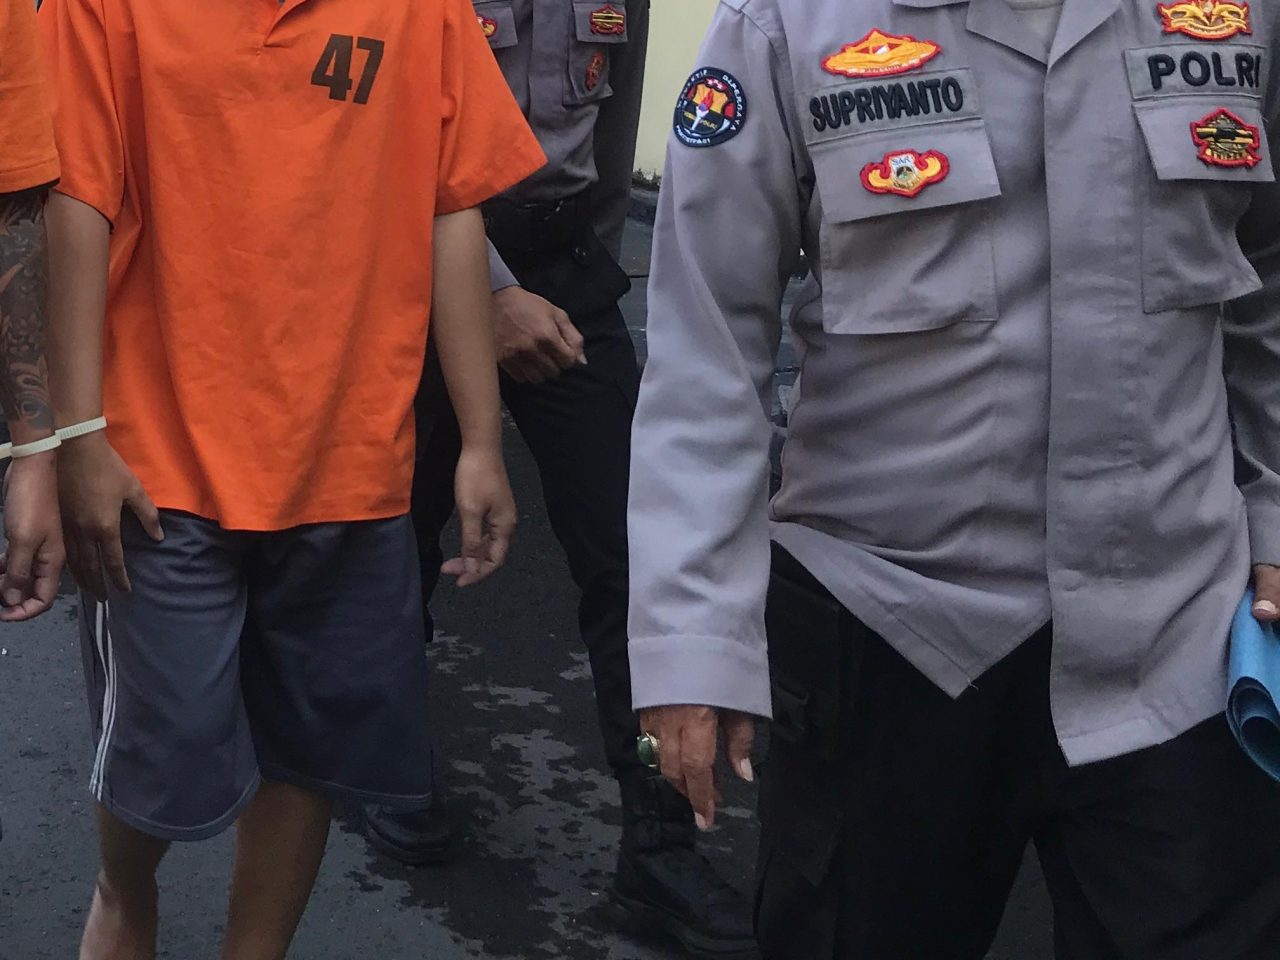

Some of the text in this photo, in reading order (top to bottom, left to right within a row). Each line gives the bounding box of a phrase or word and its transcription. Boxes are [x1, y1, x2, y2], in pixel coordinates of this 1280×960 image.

[310, 33, 385, 105] 47
[1147, 50, 1261, 90] POLRI
[809, 75, 963, 132] SUPRIYANTO
